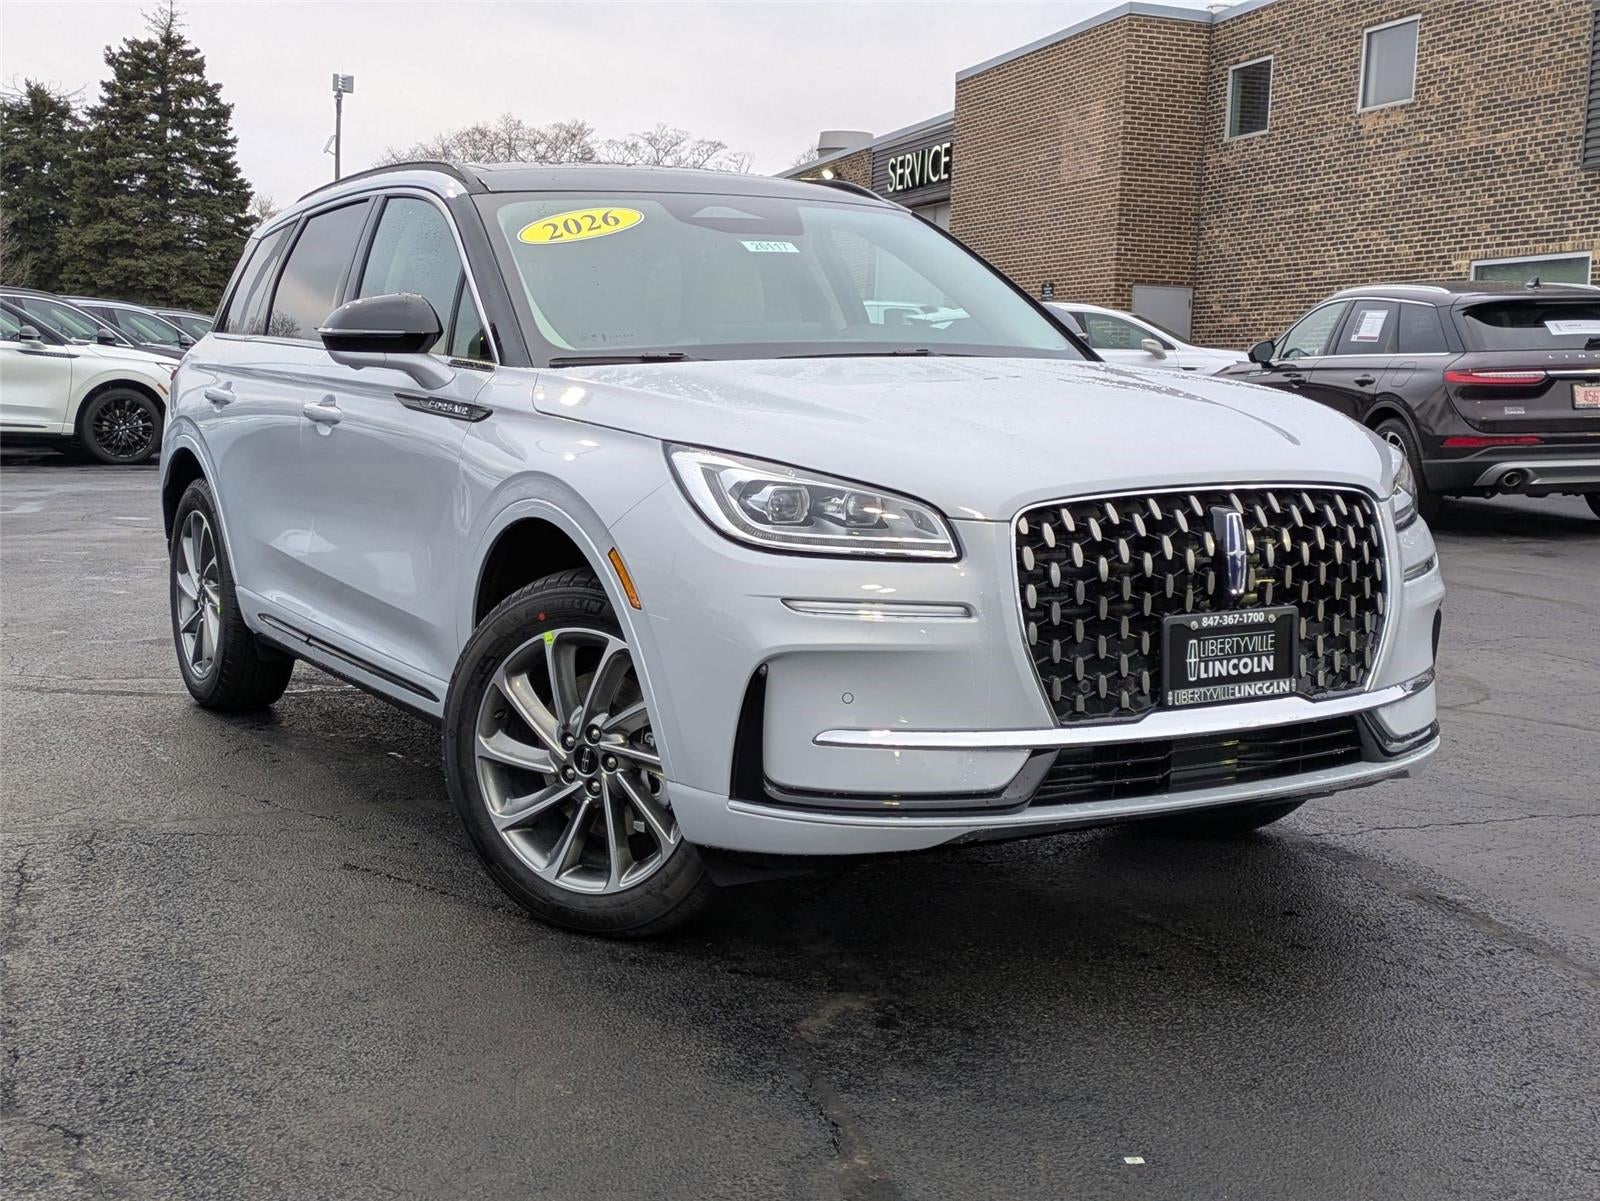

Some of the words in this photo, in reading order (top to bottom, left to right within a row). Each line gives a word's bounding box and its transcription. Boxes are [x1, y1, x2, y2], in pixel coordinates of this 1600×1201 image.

[887, 142, 951, 192] SERVICE
[542, 209, 620, 240] 2026
[750, 242, 788, 250] 26117
[428, 400, 468, 415] CORSAIR
[1202, 612, 1265, 627] 847-367-1700
[1200, 634, 1275, 657] LIBERTYVILLE
[1200, 655, 1274, 678] LINCOLN
